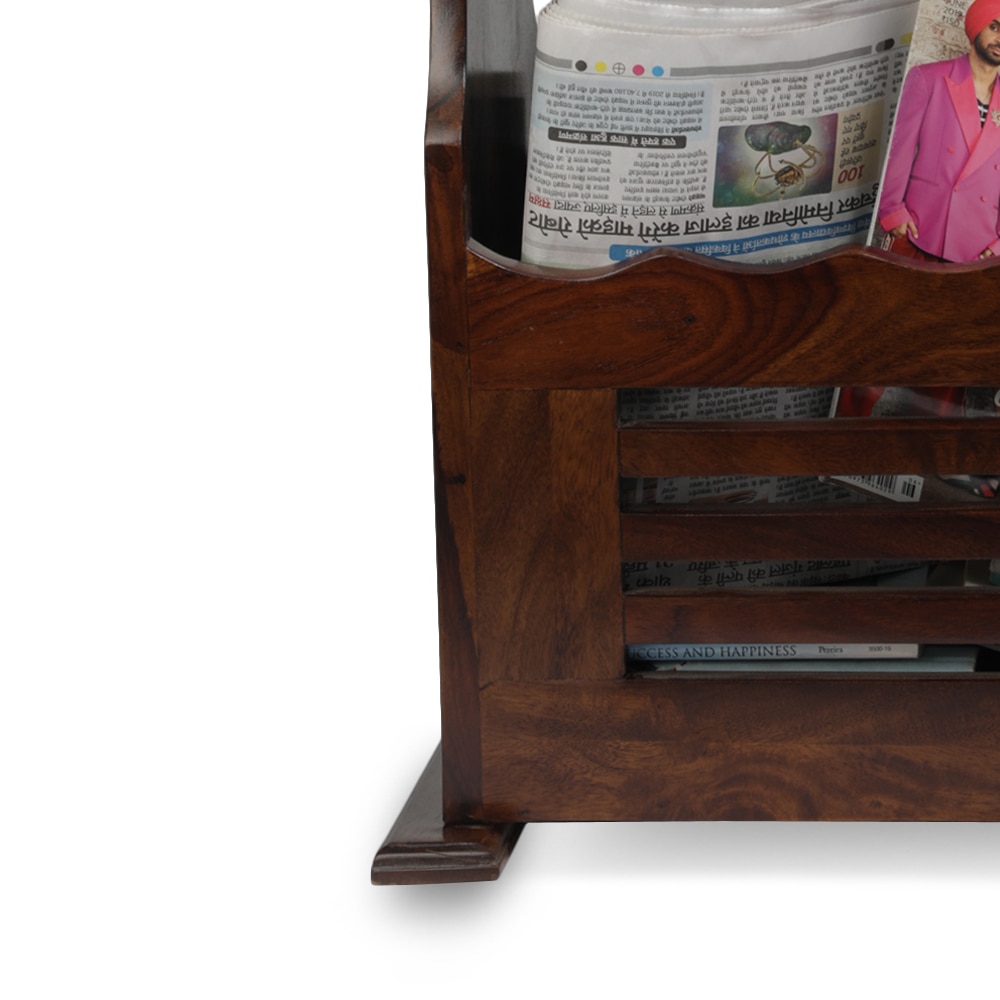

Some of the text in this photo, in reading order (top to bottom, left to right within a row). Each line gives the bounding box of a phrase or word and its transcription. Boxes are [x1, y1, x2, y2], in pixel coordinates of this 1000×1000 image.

[662, 137, 676, 146] एक
[838, 164, 864, 184] 100
[528, 192, 551, 209] सक्षम
[554, 200, 581, 212] ज्यादा
[583, 201, 618, 216] इसलिए
[620, 205, 629, 218] में
[659, 206, 668, 219] से
[670, 203, 705, 216] संक्रमण
[764, 201, 834, 226] निमोनिया
[528, 210, 572, 238] रोबोट
[576, 216, 634, 240] माइक्रो
[683, 212, 732, 235] इलाज
[736, 214, 760, 231] का
[638, 222, 680, 243] करेंगे
[683, 647, 715, 658] AND
[720, 645, 797, 657] HAPPINESS
